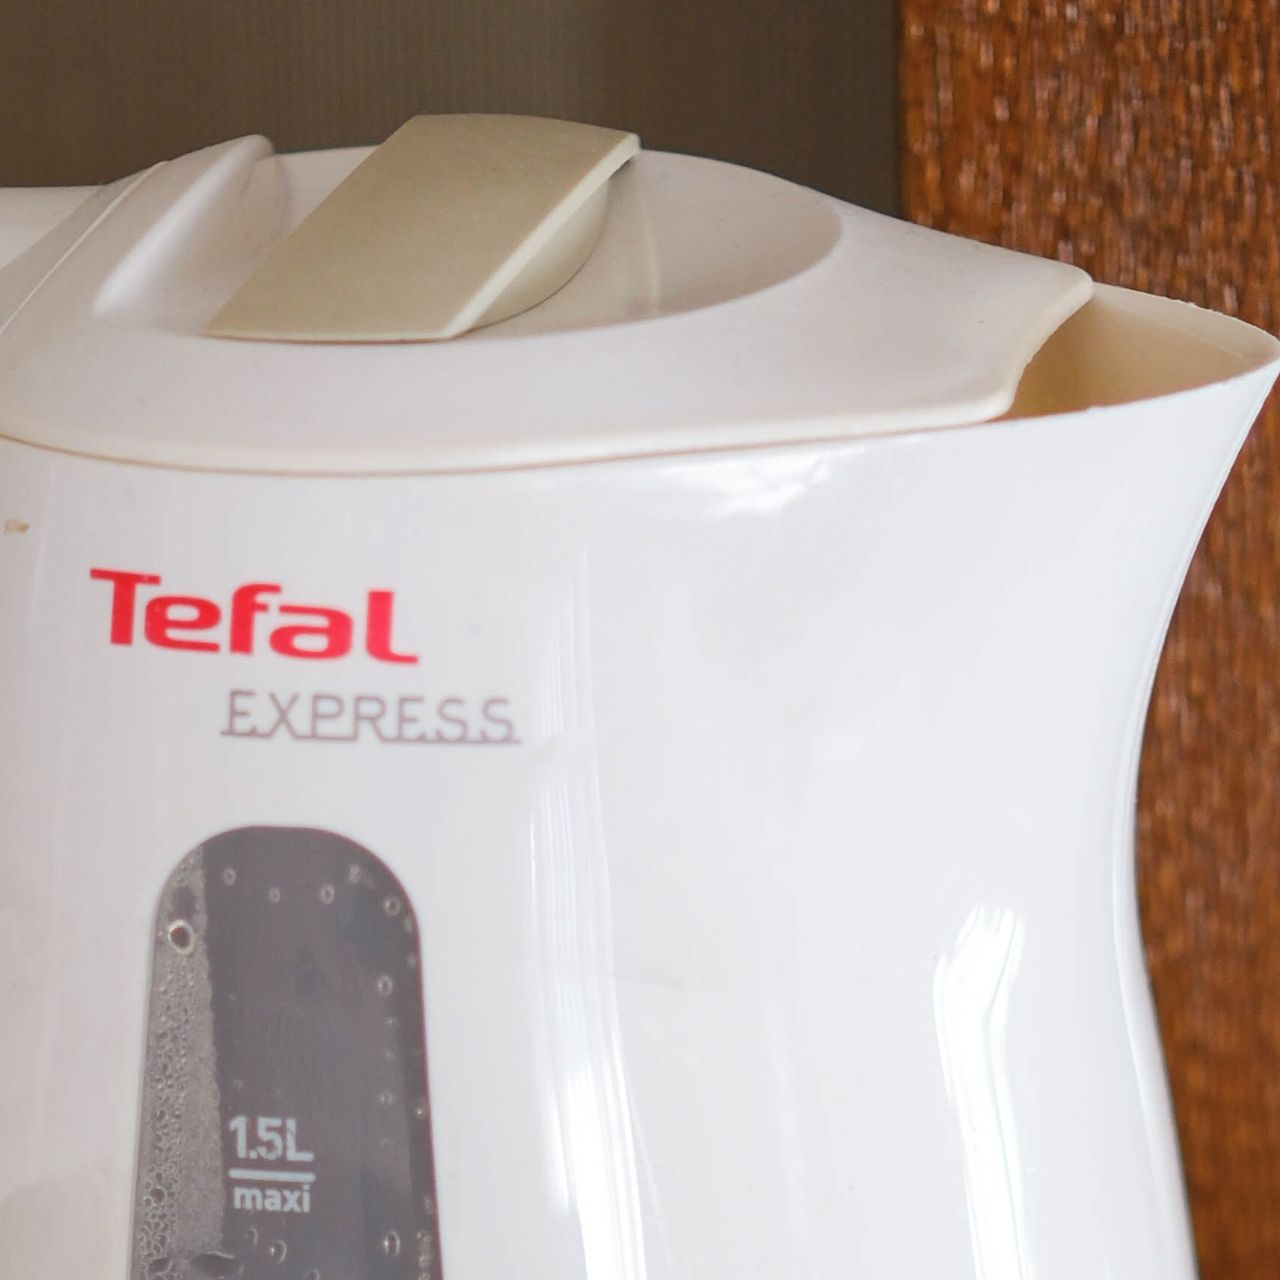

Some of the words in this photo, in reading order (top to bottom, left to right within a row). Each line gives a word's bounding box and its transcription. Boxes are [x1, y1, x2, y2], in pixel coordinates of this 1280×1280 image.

[90, 568, 419, 664] Tefal
[221, 688, 522, 745] EXPRESS
[229, 1115, 314, 1162] 1.5L
[234, 1185, 310, 1213] maxi
